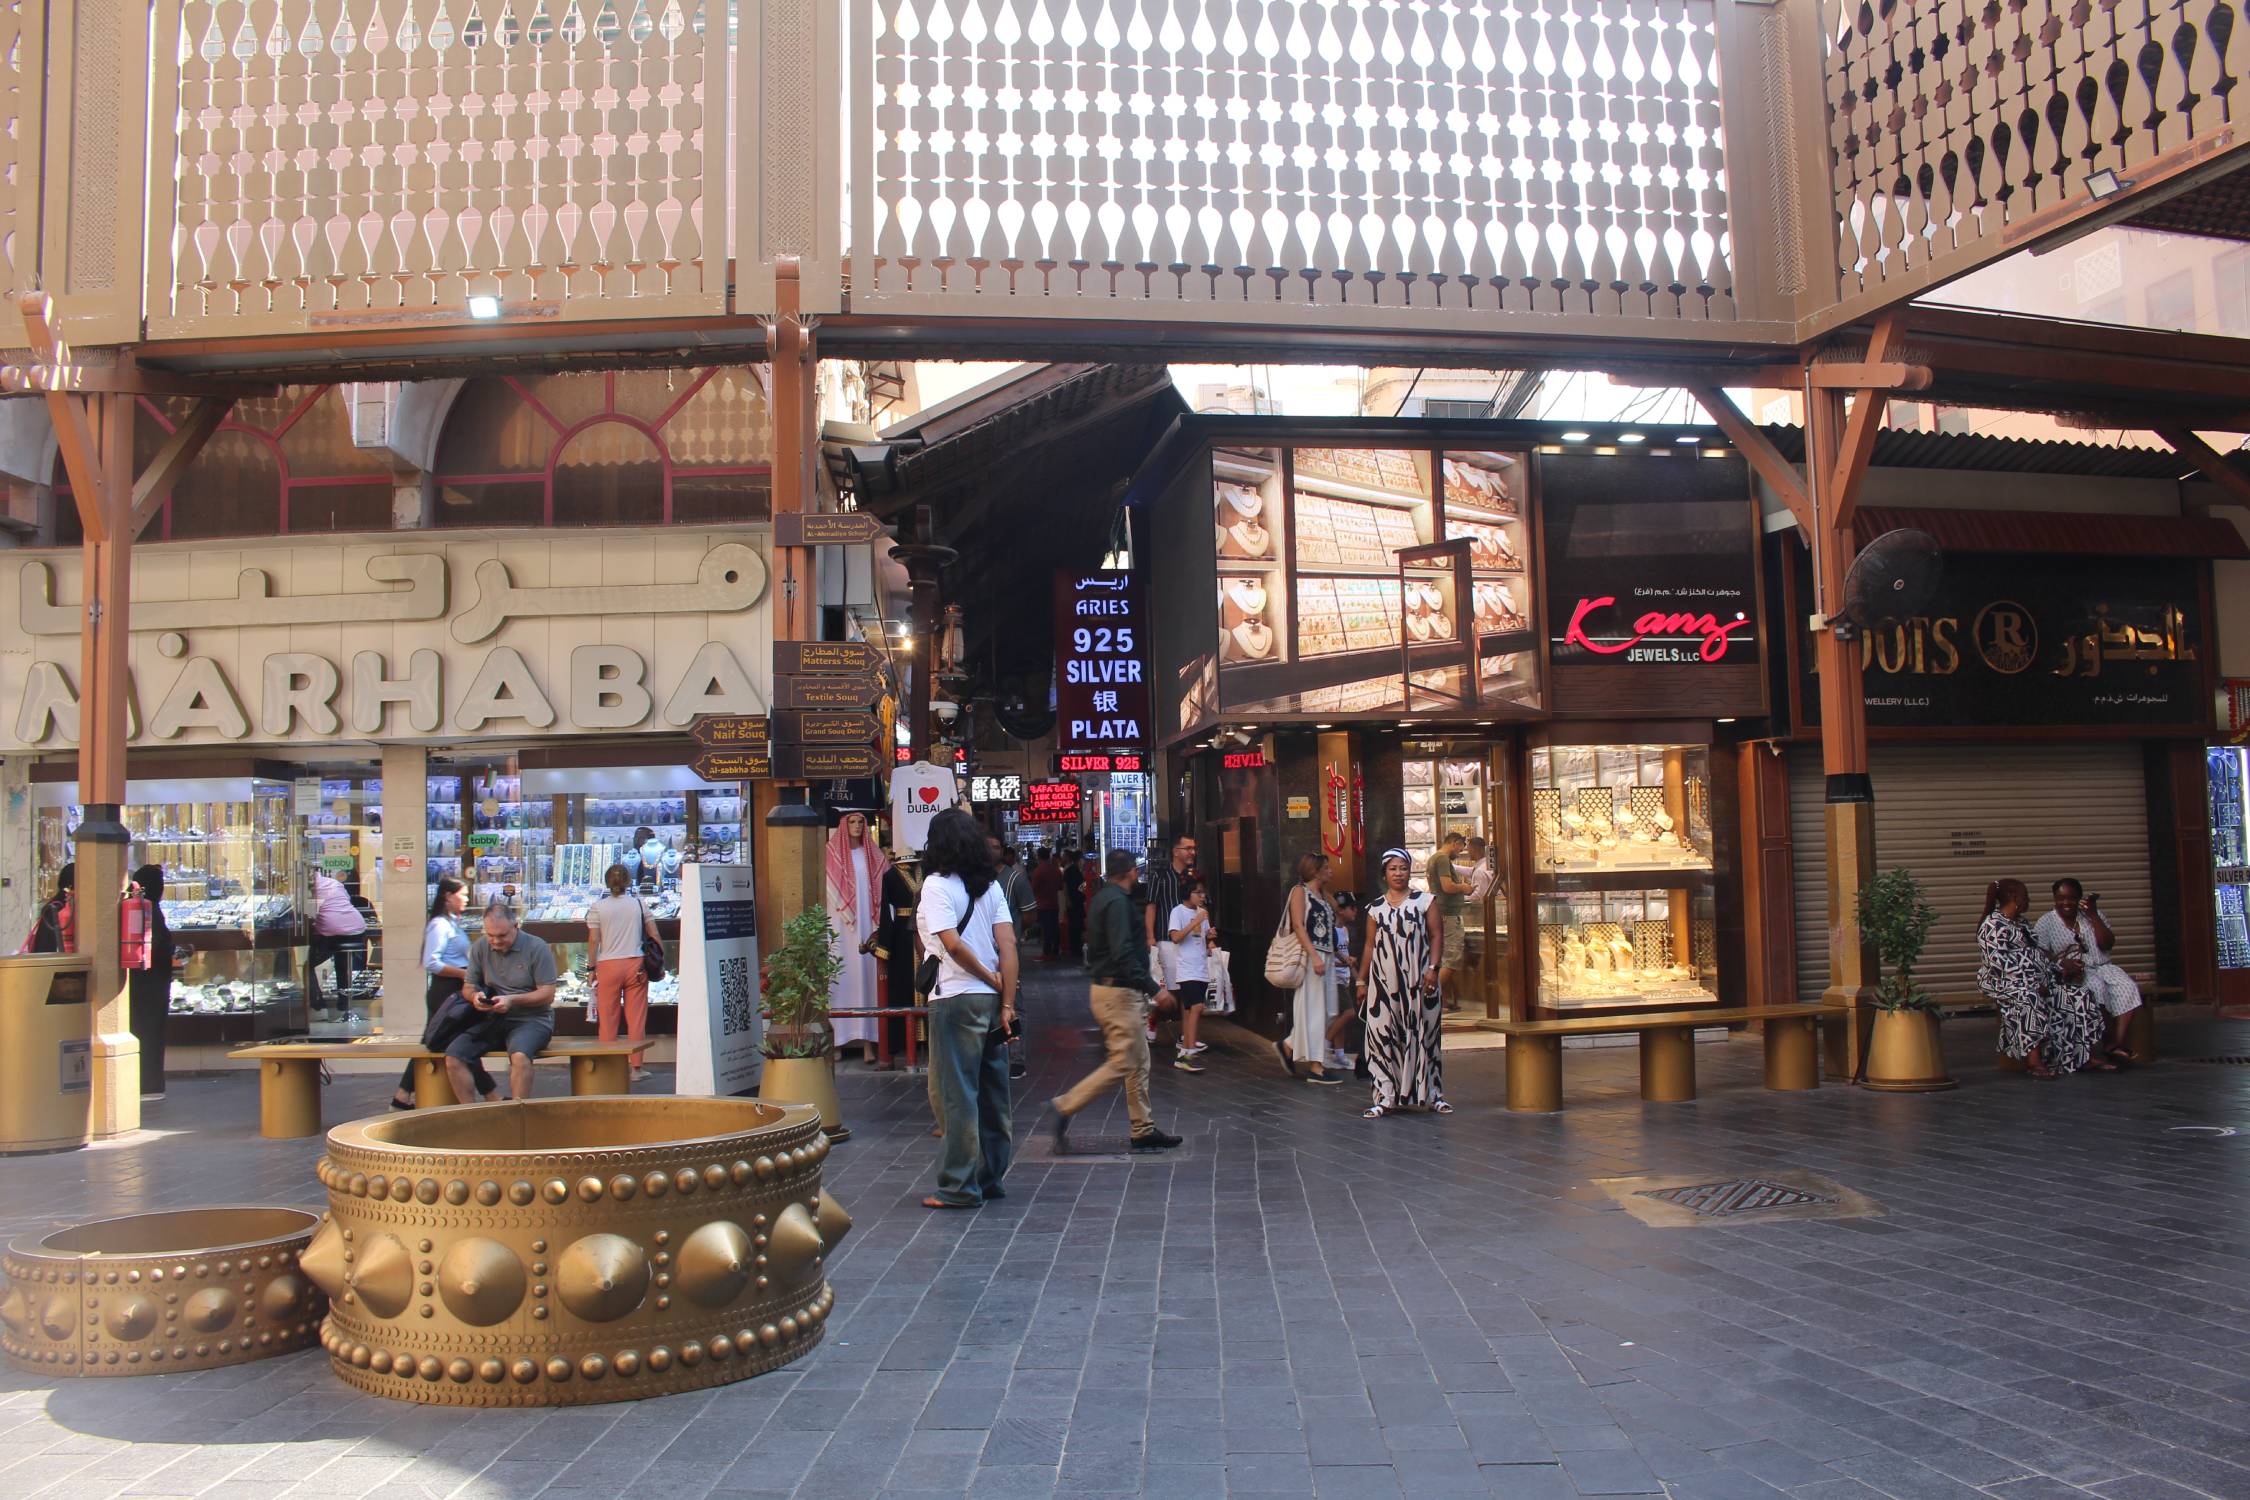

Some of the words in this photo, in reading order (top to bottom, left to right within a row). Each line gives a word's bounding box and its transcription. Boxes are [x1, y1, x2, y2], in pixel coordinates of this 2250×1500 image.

[1075, 574, 1129, 590] اريس
[19, 542, 767, 660] مرحبا
[1076, 600, 1129, 615] ARIES
[1564, 596, 1750, 662] Kanz
[1073, 628, 1134, 652] 925
[839, 648, 865, 657] سوق
[1628, 648, 1679, 662] JEWELS
[1681, 653, 1700, 662] LLC
[843, 657, 865, 666] Souq
[1066, 660, 1141, 684] SILVER
[15, 641, 766, 744] MARHABA
[805, 693, 834, 701] Textile
[836, 693, 858, 703] Souq
[1093, 690, 1119, 712] 银
[1864, 697, 1902, 705] WELLERY
[738, 720, 765, 730] سوق
[1071, 719, 1140, 739] PLATA
[713, 730, 736, 740] Naif
[738, 730, 766, 740] Souq
[827, 728, 846, 736] Souq
[1061, 756, 1110, 770] SILVER
[1115, 756, 1140, 770] 925
[990, 778, 998, 788] &
[1000, 778, 1020, 788] 22K
[1110, 774, 1139, 784] SILVER
[907, 787, 912, 803] I
[990, 789, 1011, 800] BUY
[907, 805, 940, 813] DUBAI
[1034, 800, 1075, 808] DIAMOND
[470, 836, 498, 847] tabby
[324, 859, 351, 868] tabby
[2216, 869, 2244, 883] SILVER
